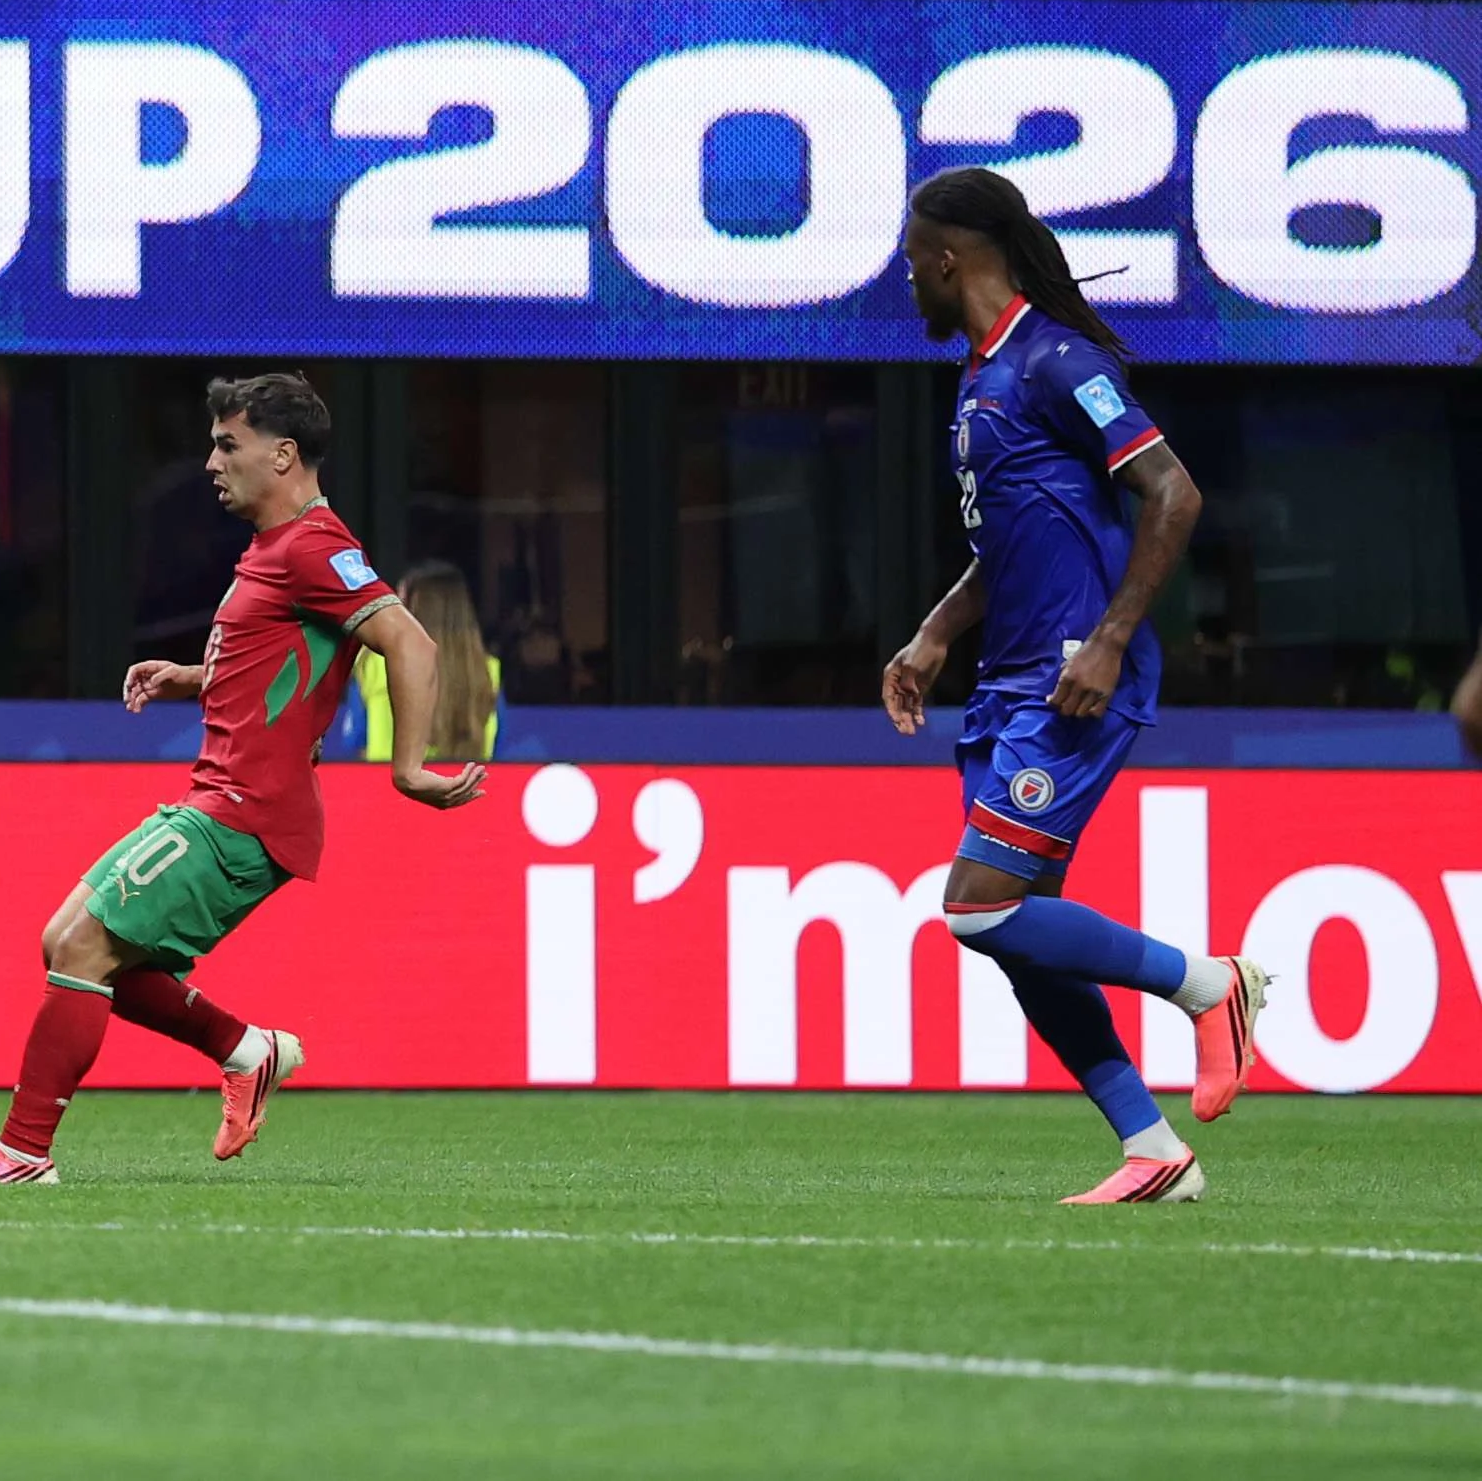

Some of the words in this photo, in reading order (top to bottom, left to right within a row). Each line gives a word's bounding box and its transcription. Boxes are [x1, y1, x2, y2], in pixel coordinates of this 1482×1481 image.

[330, 37, 1478, 313] 2026
[115, 823, 190, 886] 10
[1138, 785, 1482, 1093] lo
